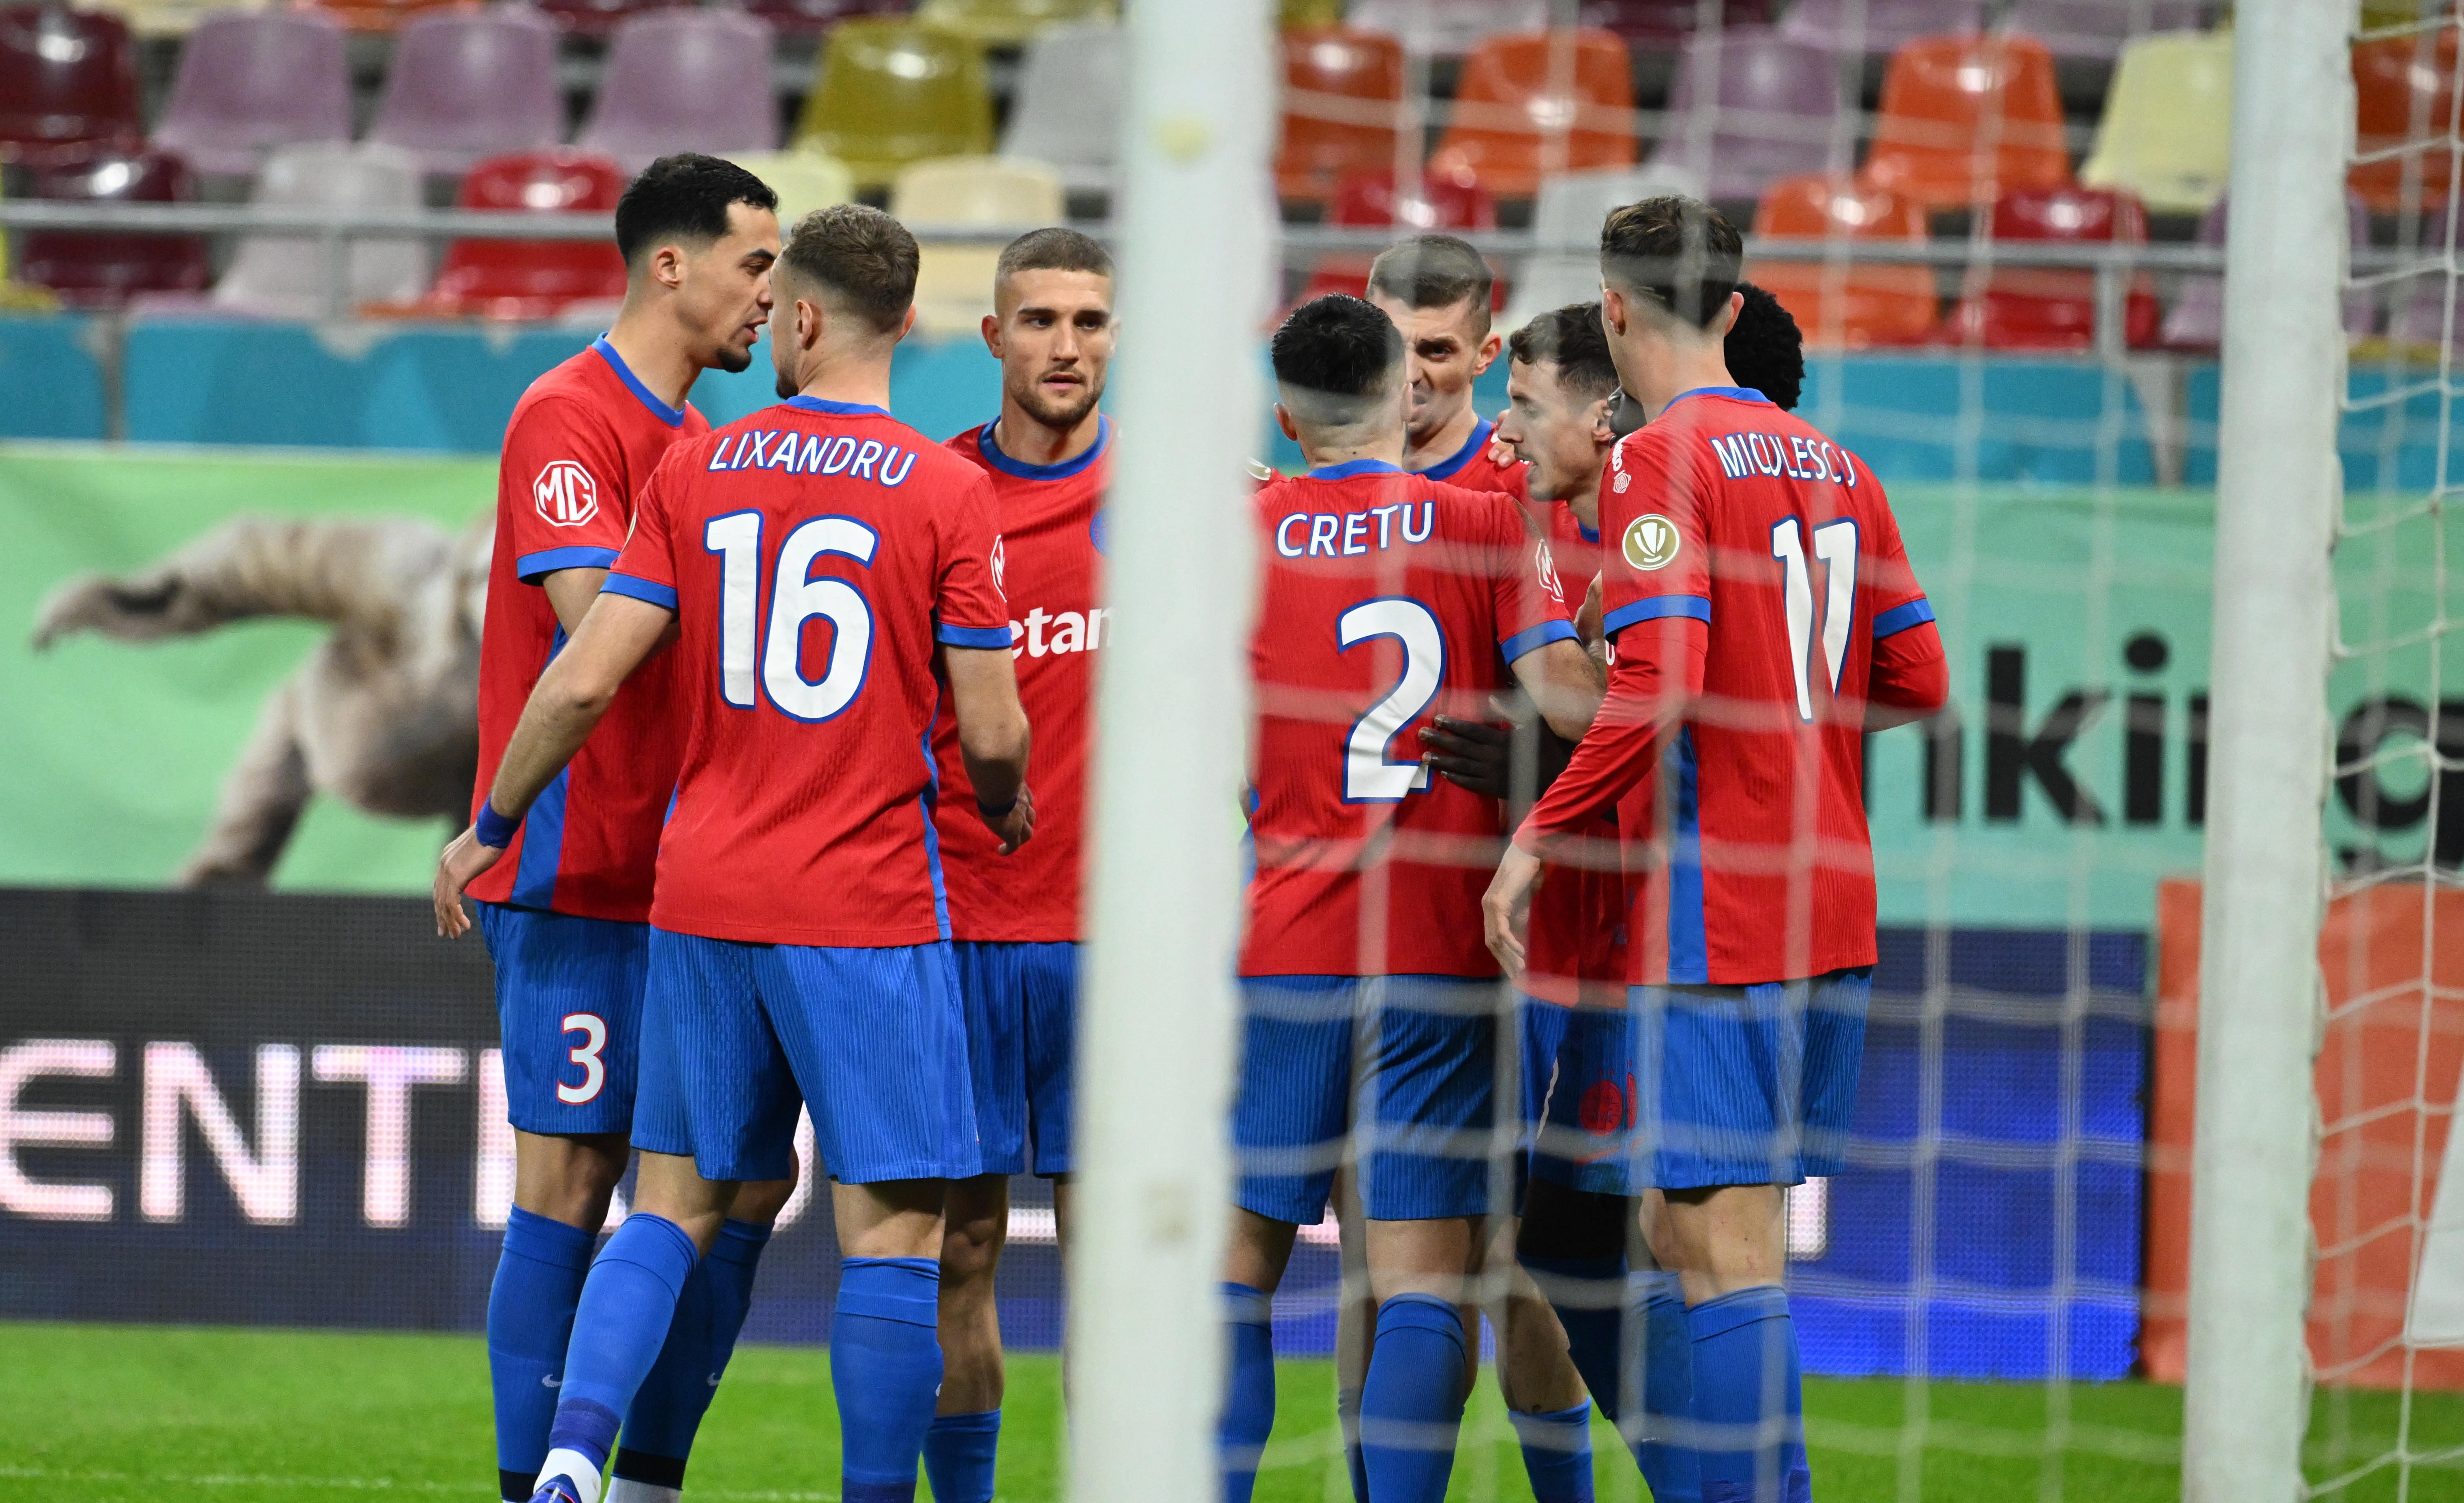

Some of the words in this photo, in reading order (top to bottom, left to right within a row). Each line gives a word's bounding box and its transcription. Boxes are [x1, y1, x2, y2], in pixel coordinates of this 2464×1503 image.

[538, 466, 594, 521] MG
[707, 429, 919, 487] LIXANDRU
[1275, 499, 1436, 559] CRETU
[703, 508, 880, 724] 16
[1771, 513, 1860, 724] 11
[1336, 595, 1447, 804] 2
[556, 1011, 608, 1106] 3
